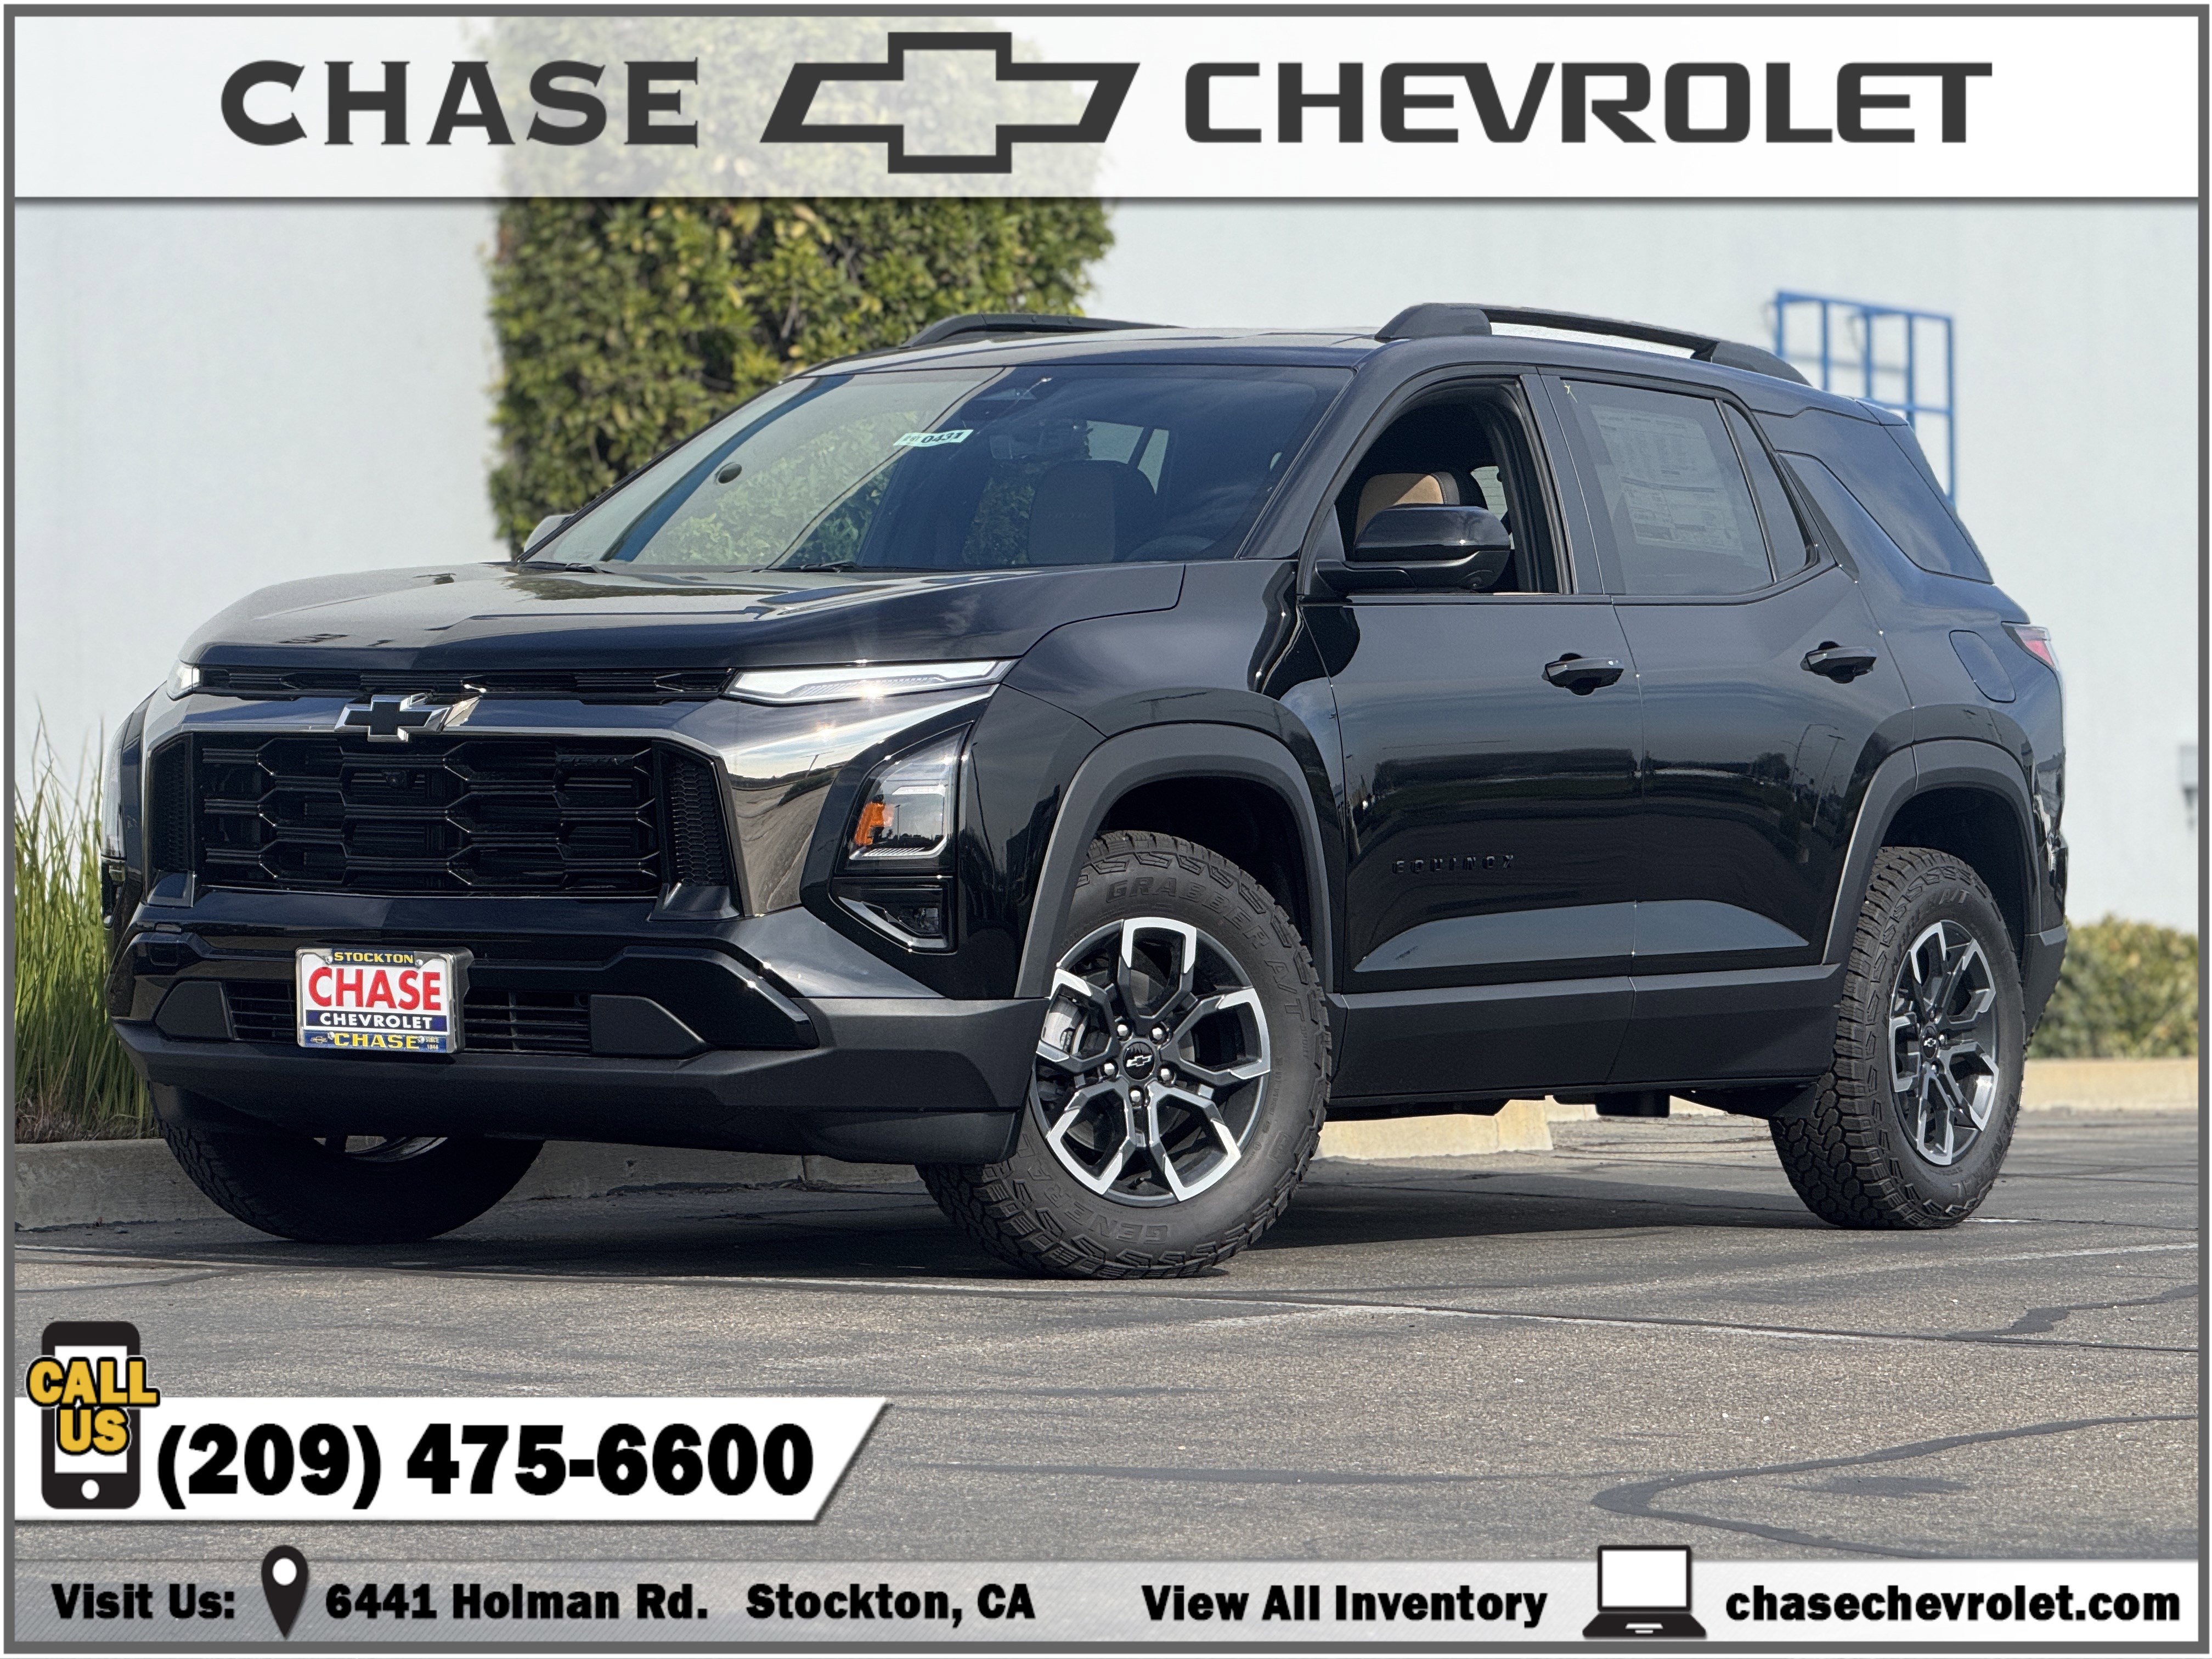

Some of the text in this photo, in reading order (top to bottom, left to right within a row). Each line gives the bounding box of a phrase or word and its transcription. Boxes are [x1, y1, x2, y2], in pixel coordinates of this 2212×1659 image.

[1392, 854, 1514, 874] EQUINOX
[1106, 877, 1271, 950] GRABBER
[334, 952, 414, 964] STOCKTON
[308, 967, 442, 1011] CHASE
[320, 1012, 432, 1030] CHEVROLET
[334, 1032, 420, 1050] CHASE
[1017, 1133, 1169, 1245] GENERAL
